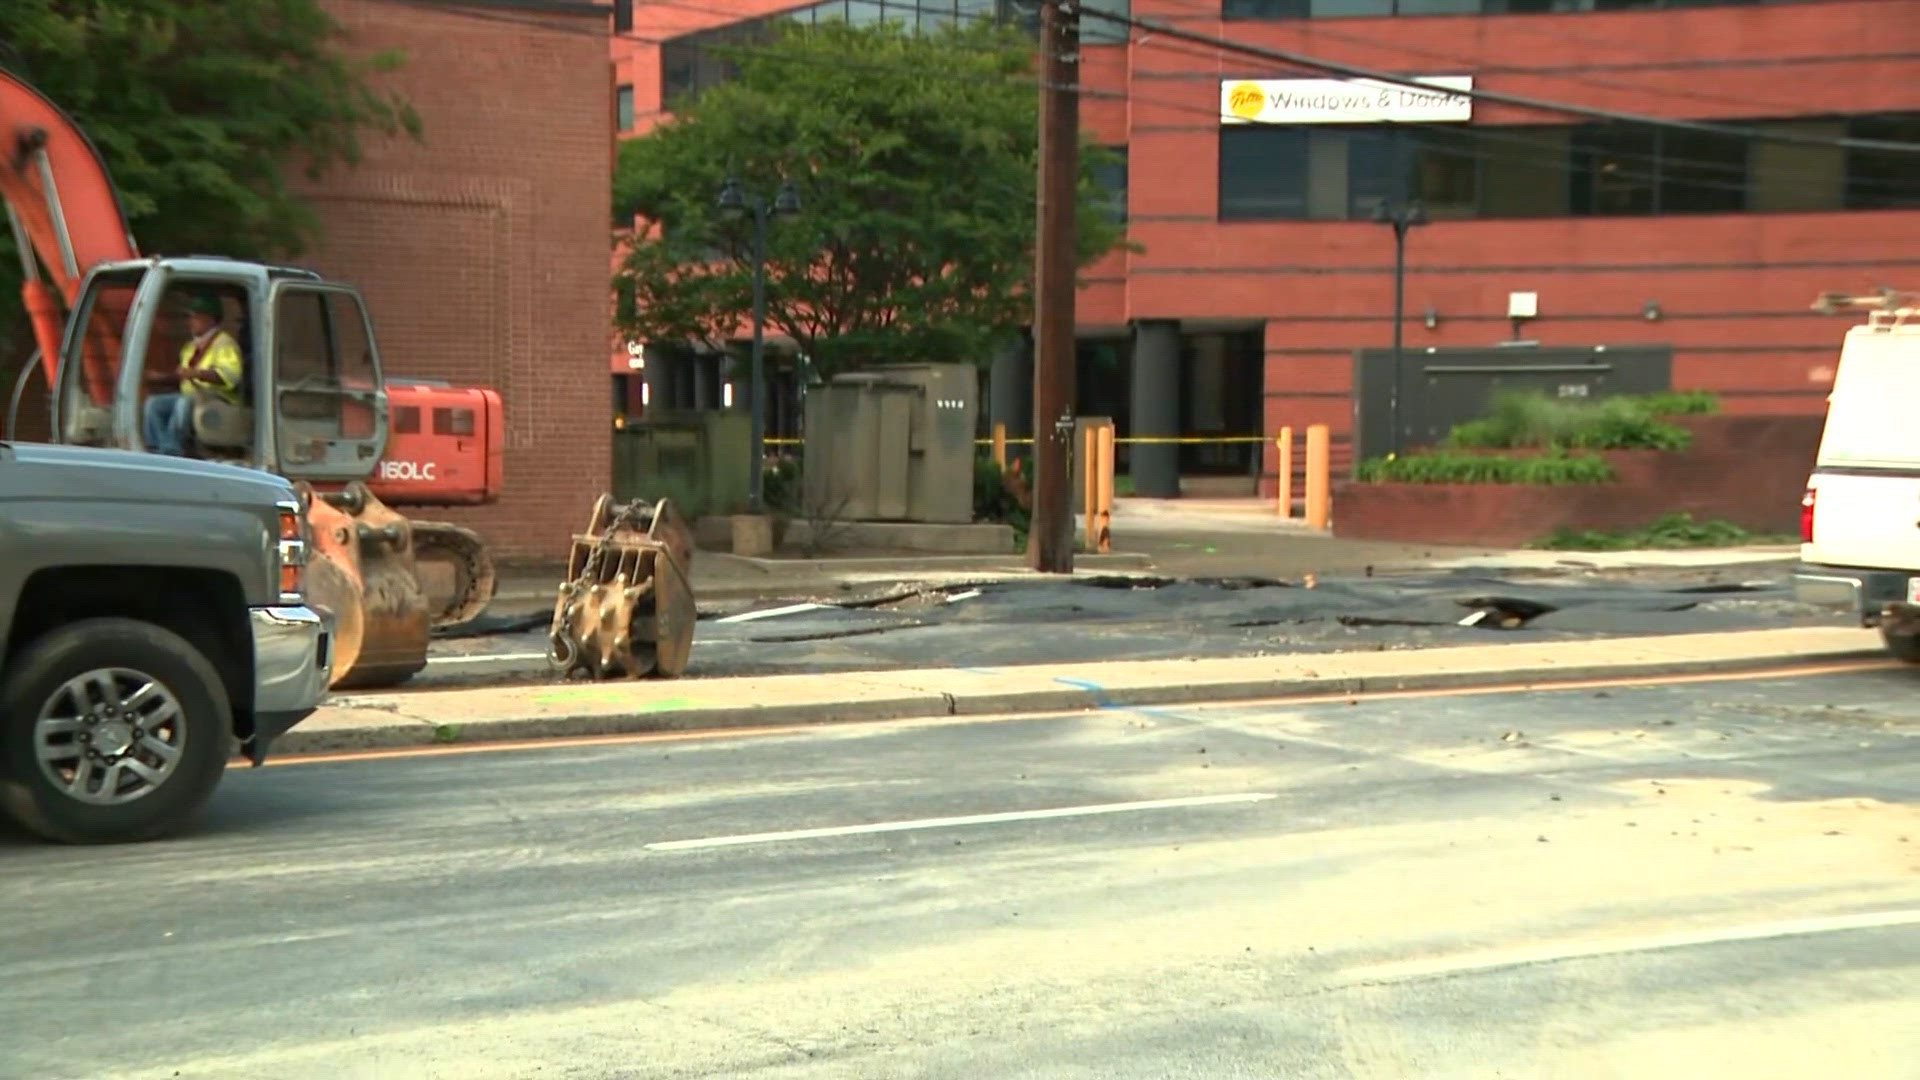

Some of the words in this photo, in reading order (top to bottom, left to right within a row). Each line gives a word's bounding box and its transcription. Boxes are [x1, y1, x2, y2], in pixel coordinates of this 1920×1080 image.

[1269, 92, 1370, 110] Windows
[1377, 88, 1391, 108] &
[1400, 90, 1466, 108] Doors
[380, 461, 436, 480] 160LC
